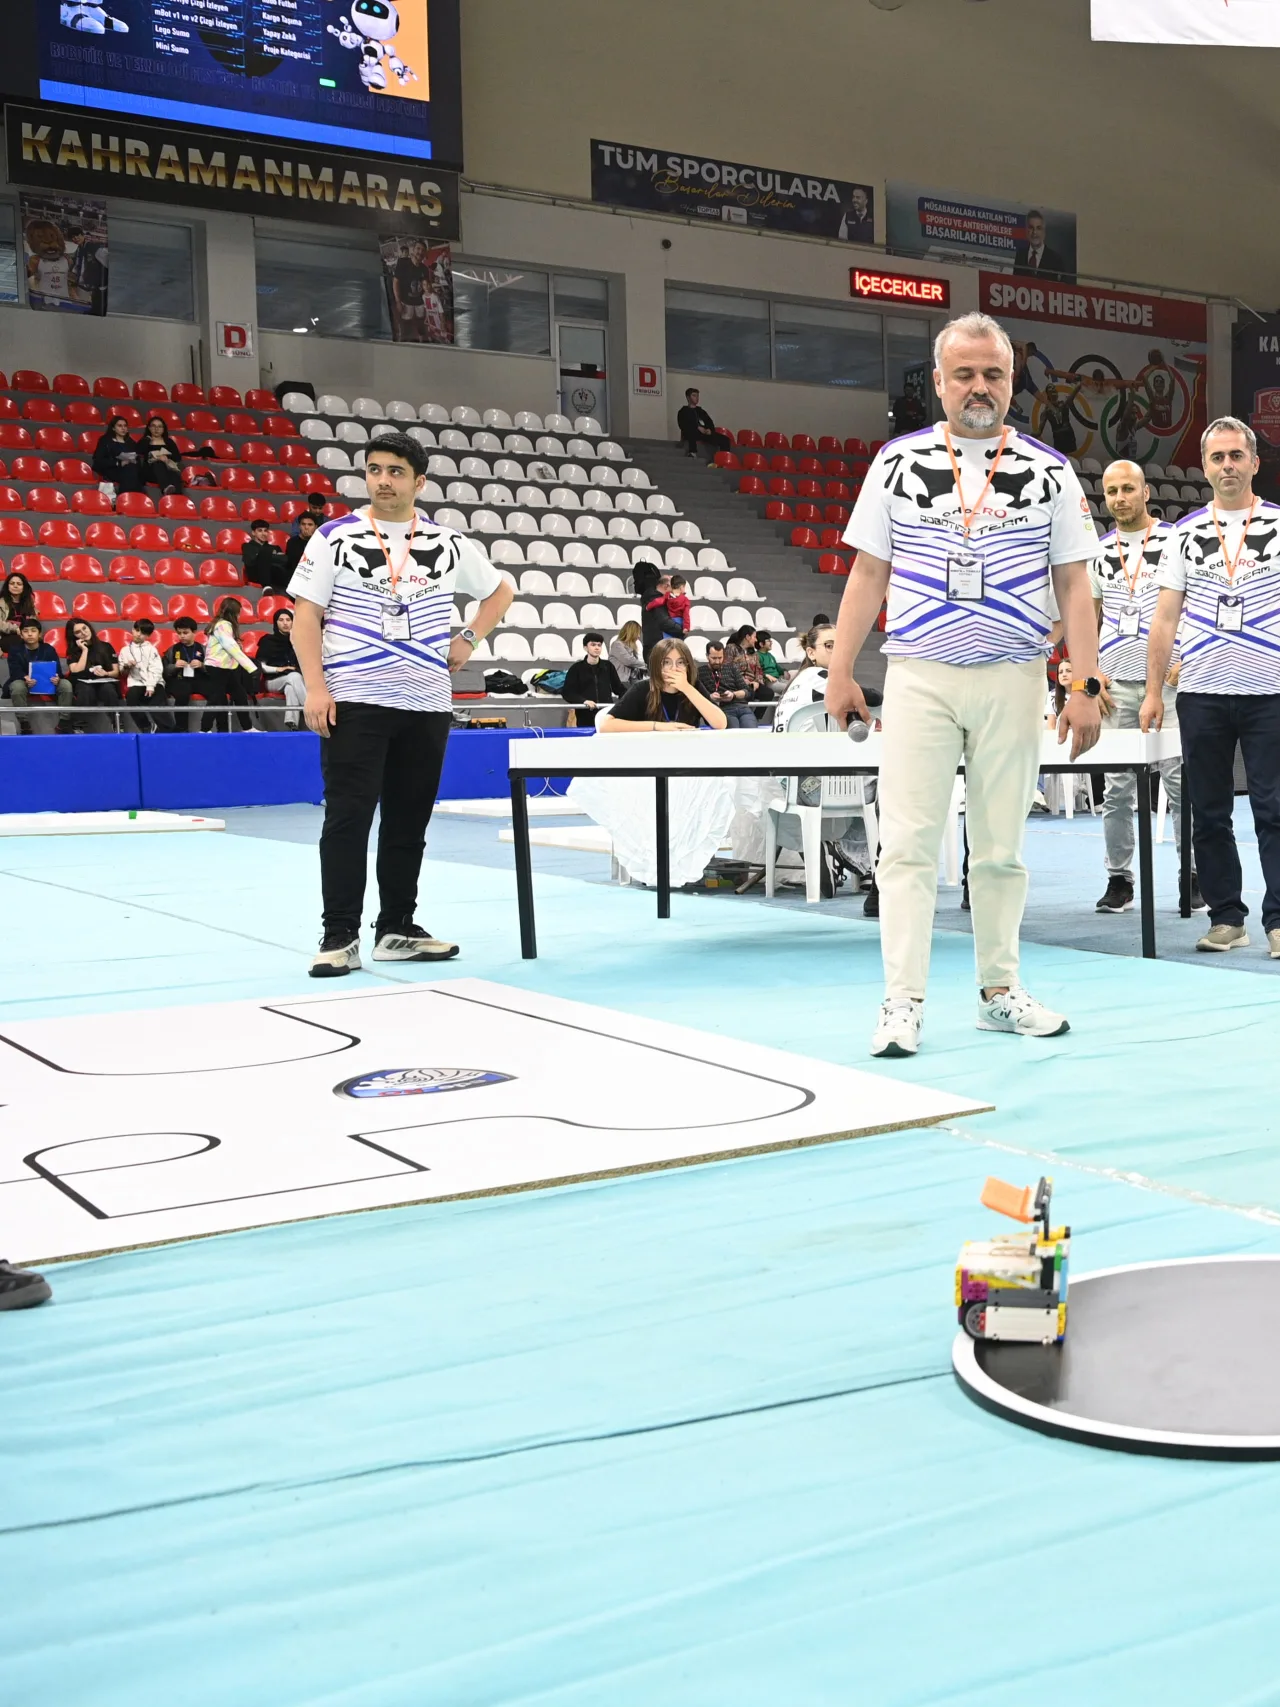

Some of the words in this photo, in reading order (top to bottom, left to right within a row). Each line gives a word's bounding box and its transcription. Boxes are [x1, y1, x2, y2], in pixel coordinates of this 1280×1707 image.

[154, 8, 172, 18] mBot
[182, 14, 190, 22] ve
[190, 14, 198, 22] v2
[200, 16, 214, 27] Çizgi
[216, 18, 238, 31] İzleyen
[262, 12, 280, 23] Kargo
[154, 25, 171, 36] Lego
[172, 28, 190, 38] Sumo
[262, 28, 280, 40] Yapay
[156, 42, 170, 51] Mini
[170, 44, 190, 54] Sumo
[263, 44, 280, 56] Proje
[280, 48, 311, 60] Kategorisi
[21, 122, 442, 226] KAHRAMANMARAŞ
[598, 144, 658, 174] TÜM
[666, 155, 841, 203] SPORCULARA
[924, 201, 976, 219] MÜSABAKALARA
[978, 210, 1003, 223] KATILAN
[1004, 214, 1018, 225] TÜM
[926, 214, 952, 226] SPORCU
[954, 218, 962, 228] VE
[963, 220, 1012, 236] ANTRENÖRLERE
[926, 225, 977, 244] BAŞARILAR
[978, 232, 1017, 250] DİLERİM.
[855, 272, 943, 301] İÇECEKLER
[989, 282, 1045, 313] SPOR
[1048, 290, 1088, 318] HER
[1091, 296, 1154, 328] YERDE
[224, 325, 247, 350] D
[638, 367, 656, 388] D
[976, 515, 1028, 536] TEAM
[1234, 566, 1270, 585] TEAM
[407, 584, 441, 602] TEAM
